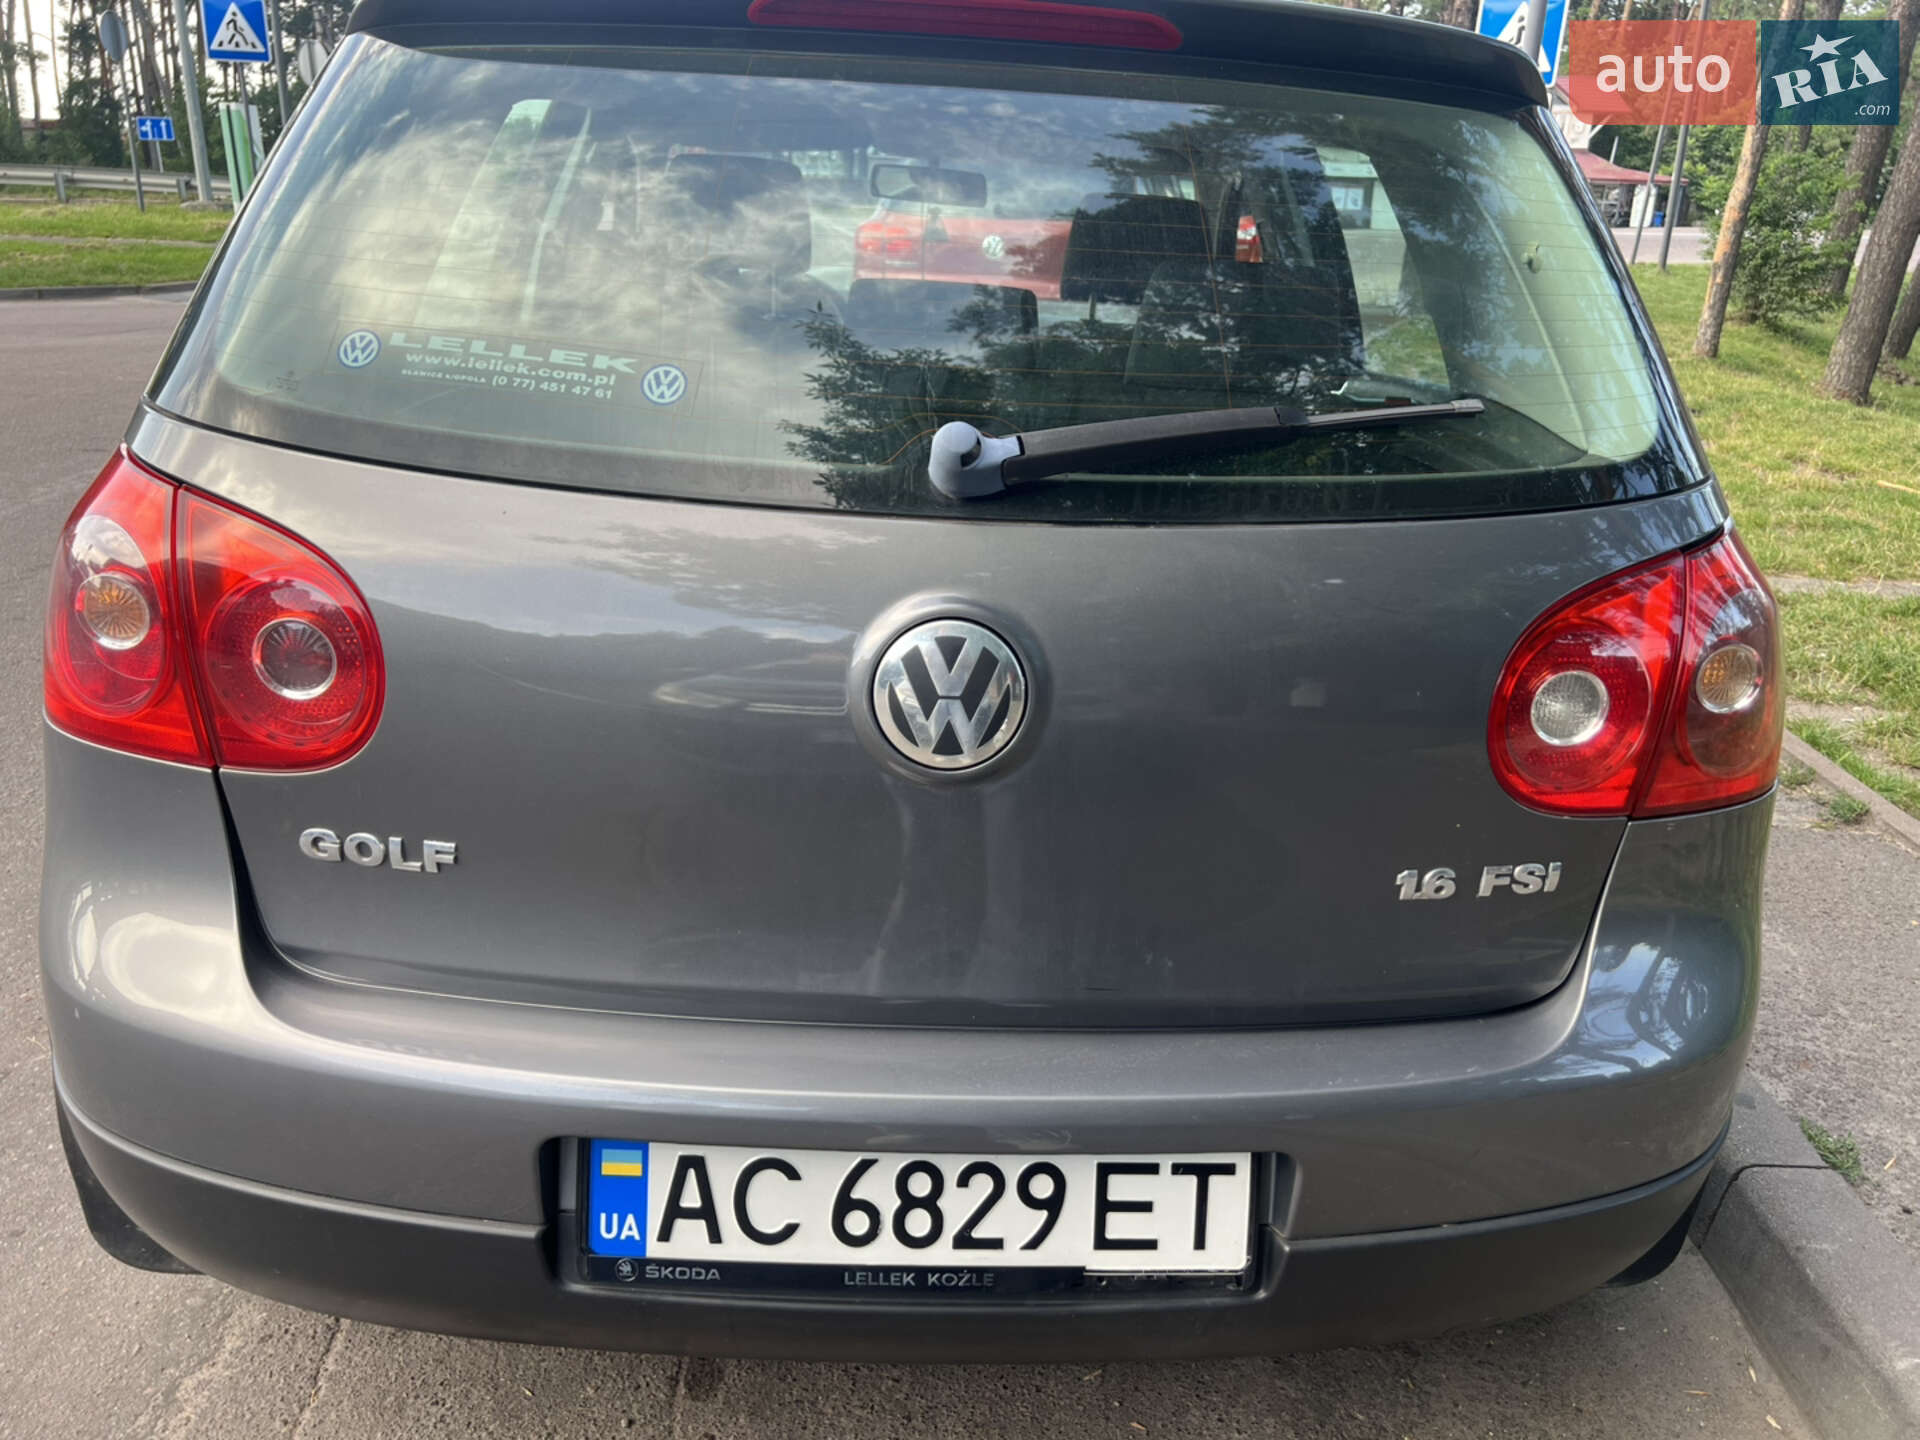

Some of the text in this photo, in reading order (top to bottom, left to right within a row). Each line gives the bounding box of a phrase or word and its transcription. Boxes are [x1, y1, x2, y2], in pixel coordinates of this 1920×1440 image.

[390, 332, 639, 374] LELLEK
[406, 353, 616, 386] www.lellek.com.pl
[512, 377, 536, 391] 77)
[539, 381, 567, 393] 451
[571, 385, 591, 396] 47
[594, 388, 613, 399] 61
[299, 827, 458, 873] GOLF
[1478, 861, 1563, 898] FSI
[656, 1155, 1237, 1252] AC 6829 ET
[598, 1213, 641, 1242] UA
[645, 1265, 721, 1282] ŠKODA
[844, 1271, 915, 1287] LELLEK
